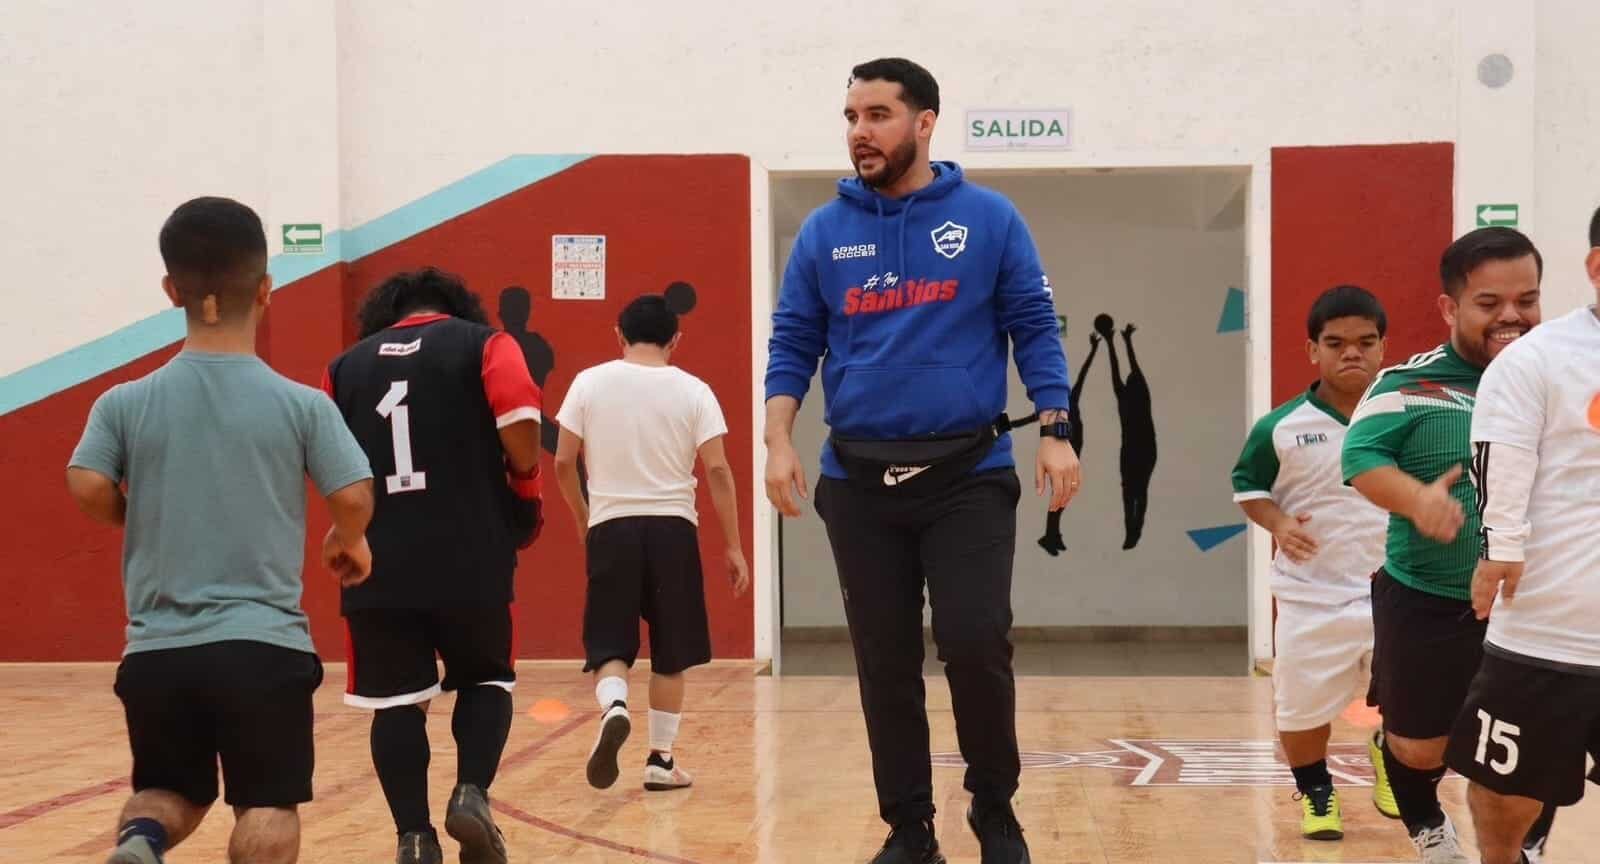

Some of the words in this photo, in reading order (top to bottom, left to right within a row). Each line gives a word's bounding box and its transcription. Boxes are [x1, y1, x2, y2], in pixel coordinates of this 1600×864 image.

[971, 119, 1064, 137] SALIDA
[832, 244, 876, 254] ARMOR
[832, 250, 876, 261] SOCCER
[375, 381, 427, 494] 1
[1474, 707, 1521, 775] 15
